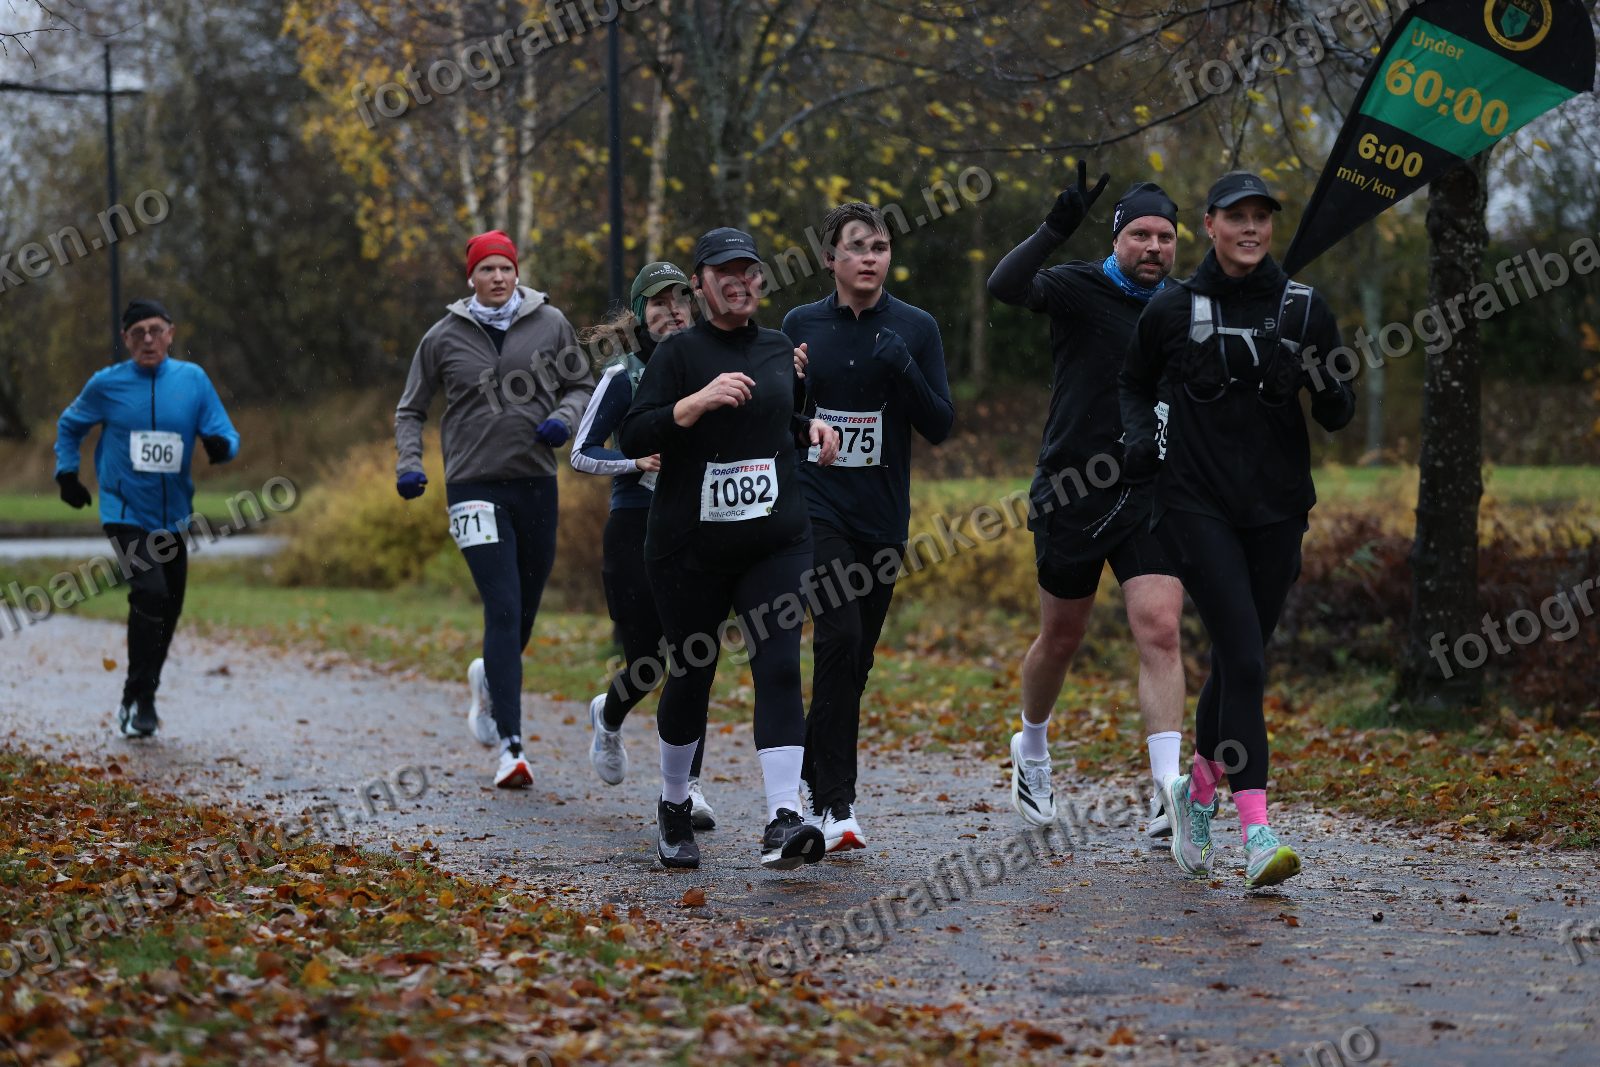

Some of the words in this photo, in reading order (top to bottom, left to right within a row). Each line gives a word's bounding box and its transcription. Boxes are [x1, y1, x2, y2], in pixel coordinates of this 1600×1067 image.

[1411, 29, 1465, 61] Under
[1385, 59, 1509, 136] 60:00
[1358, 133, 1423, 178] 6:00
[1336, 165, 1397, 200] min/km
[141, 443, 173, 465] 506
[709, 474, 773, 507] 1082
[453, 511, 481, 539] 371
[709, 510, 746, 518] WINFORCE
